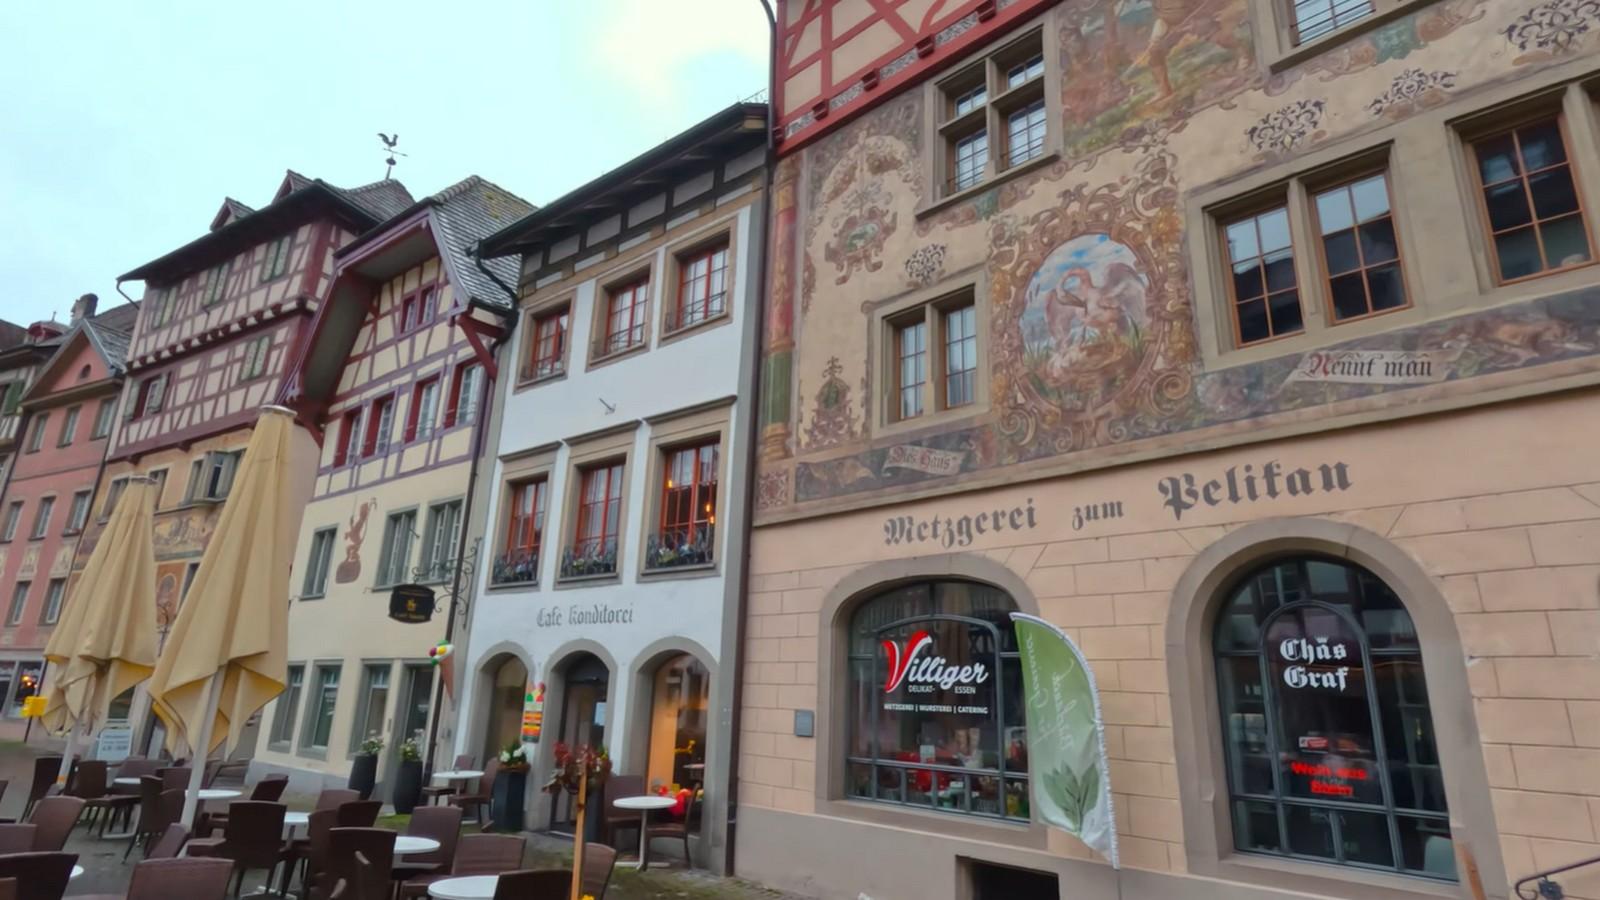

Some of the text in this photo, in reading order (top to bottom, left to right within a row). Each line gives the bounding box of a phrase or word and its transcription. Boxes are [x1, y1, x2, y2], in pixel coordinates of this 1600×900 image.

[1384, 353, 1432, 378] man
[883, 459, 1353, 548] Metzgerei zum Pelikan
[568, 602, 633, 625] Konditorei
[881, 630, 988, 693] Villiger
[954, 685, 976, 694] ESSEN
[1284, 665, 1349, 691] Graf
[957, 706, 988, 714] CATERING
